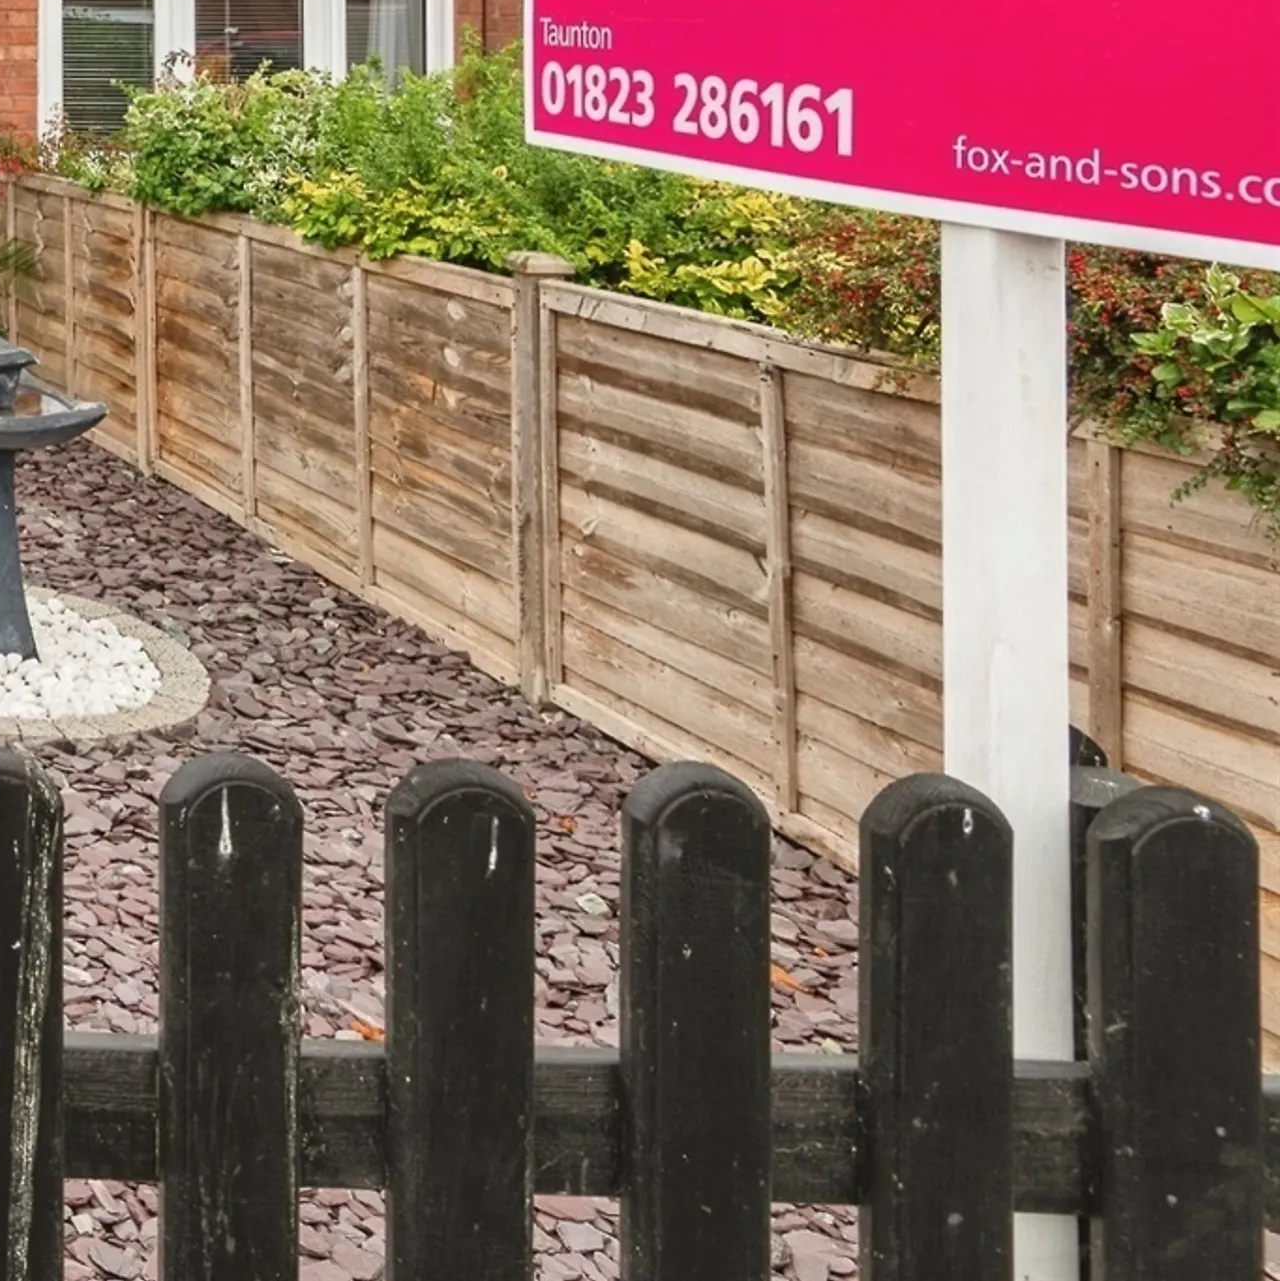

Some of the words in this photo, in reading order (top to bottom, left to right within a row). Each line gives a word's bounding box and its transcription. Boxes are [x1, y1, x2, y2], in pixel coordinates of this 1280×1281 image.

[540, 17, 612, 50] Taunton
[541, 60, 654, 127] 01823
[673, 73, 853, 156] 286161
